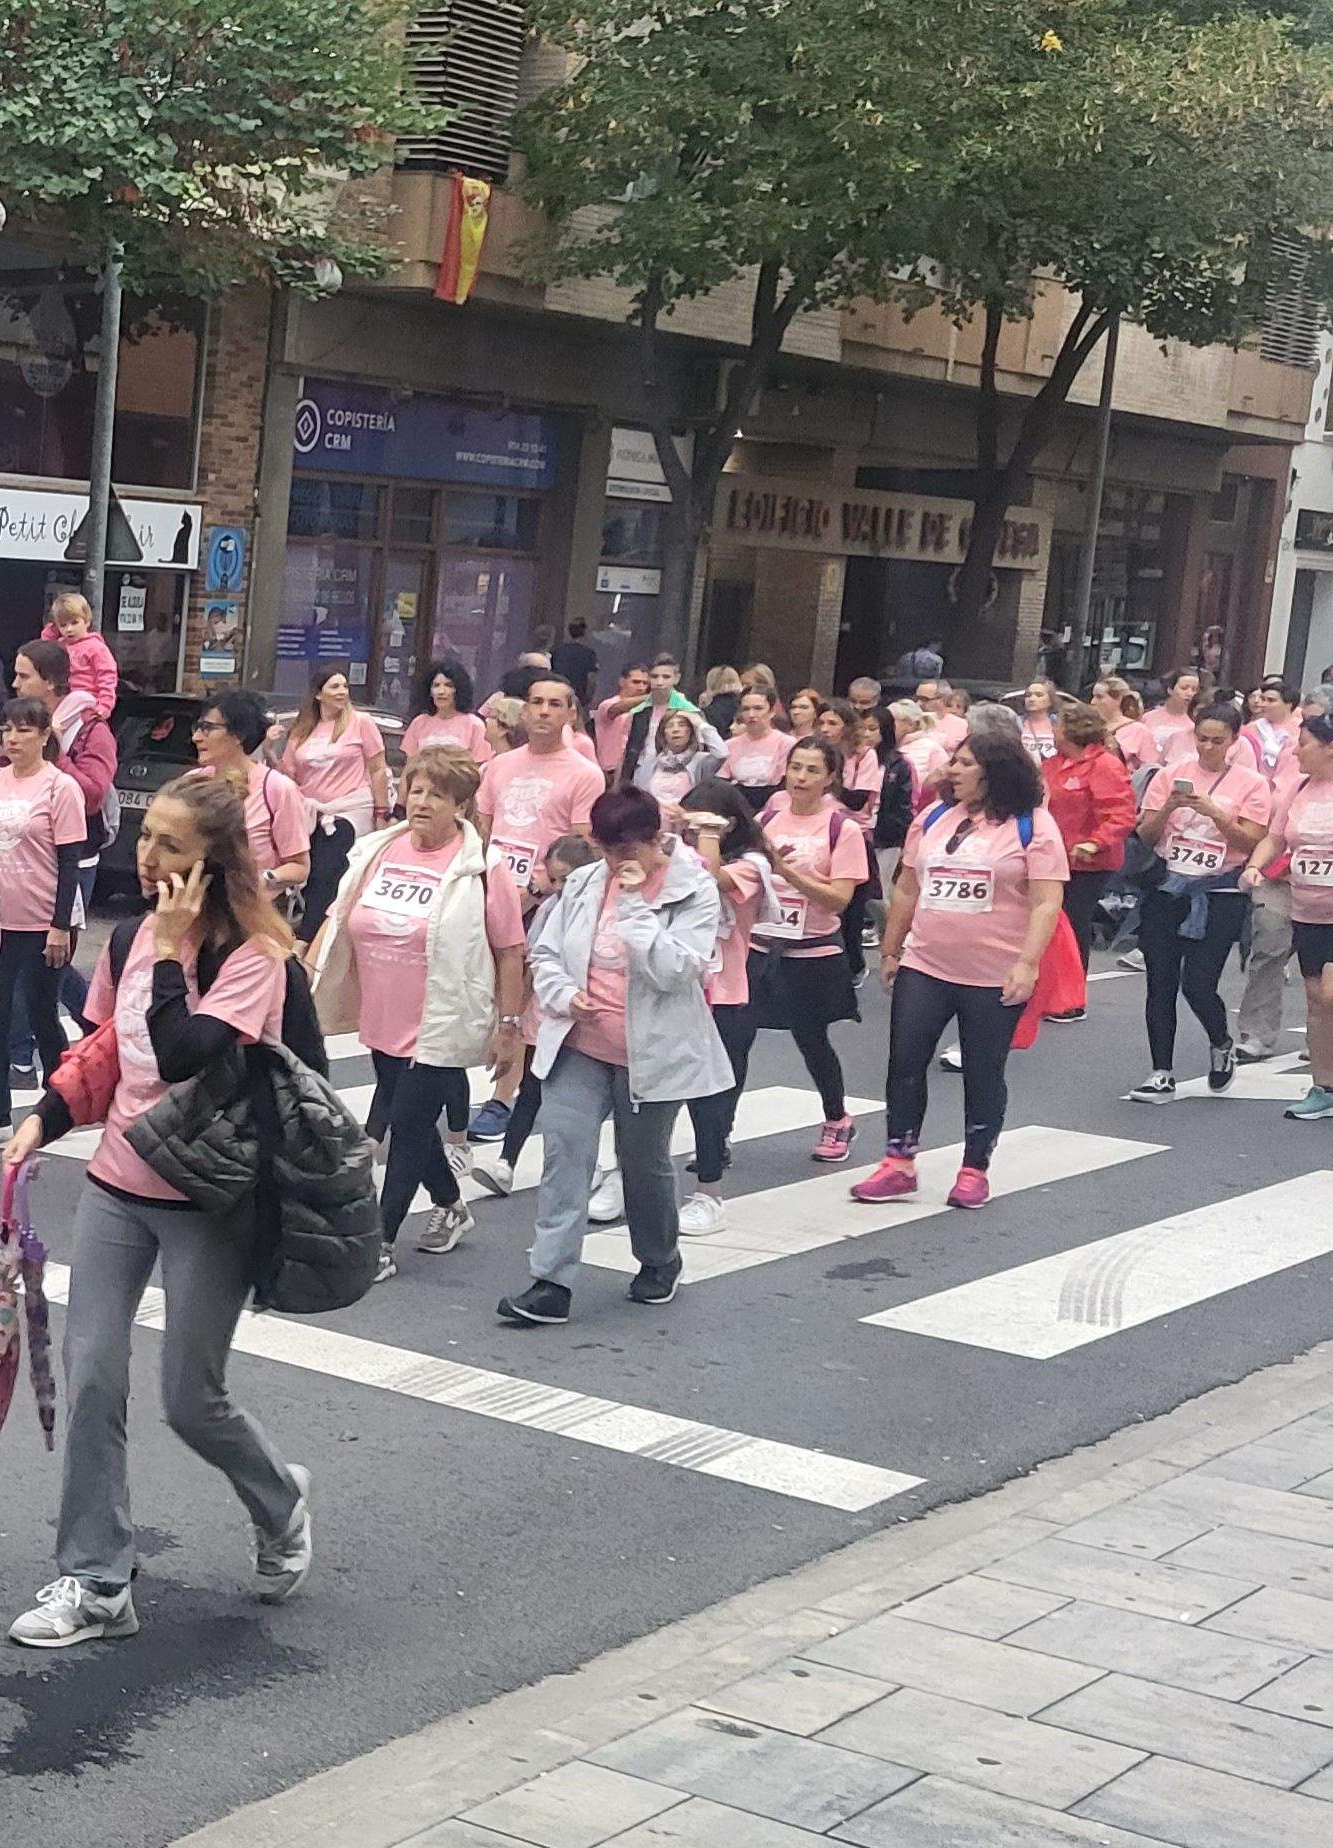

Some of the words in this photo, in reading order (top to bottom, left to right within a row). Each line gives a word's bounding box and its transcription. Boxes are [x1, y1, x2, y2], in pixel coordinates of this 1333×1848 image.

[327, 409, 396, 432] COPISTERÍA
[325, 433, 351, 450] CRM
[1169, 846, 1219, 869] 3748
[374, 880, 433, 905] 3670
[929, 880, 987, 899] 3786
